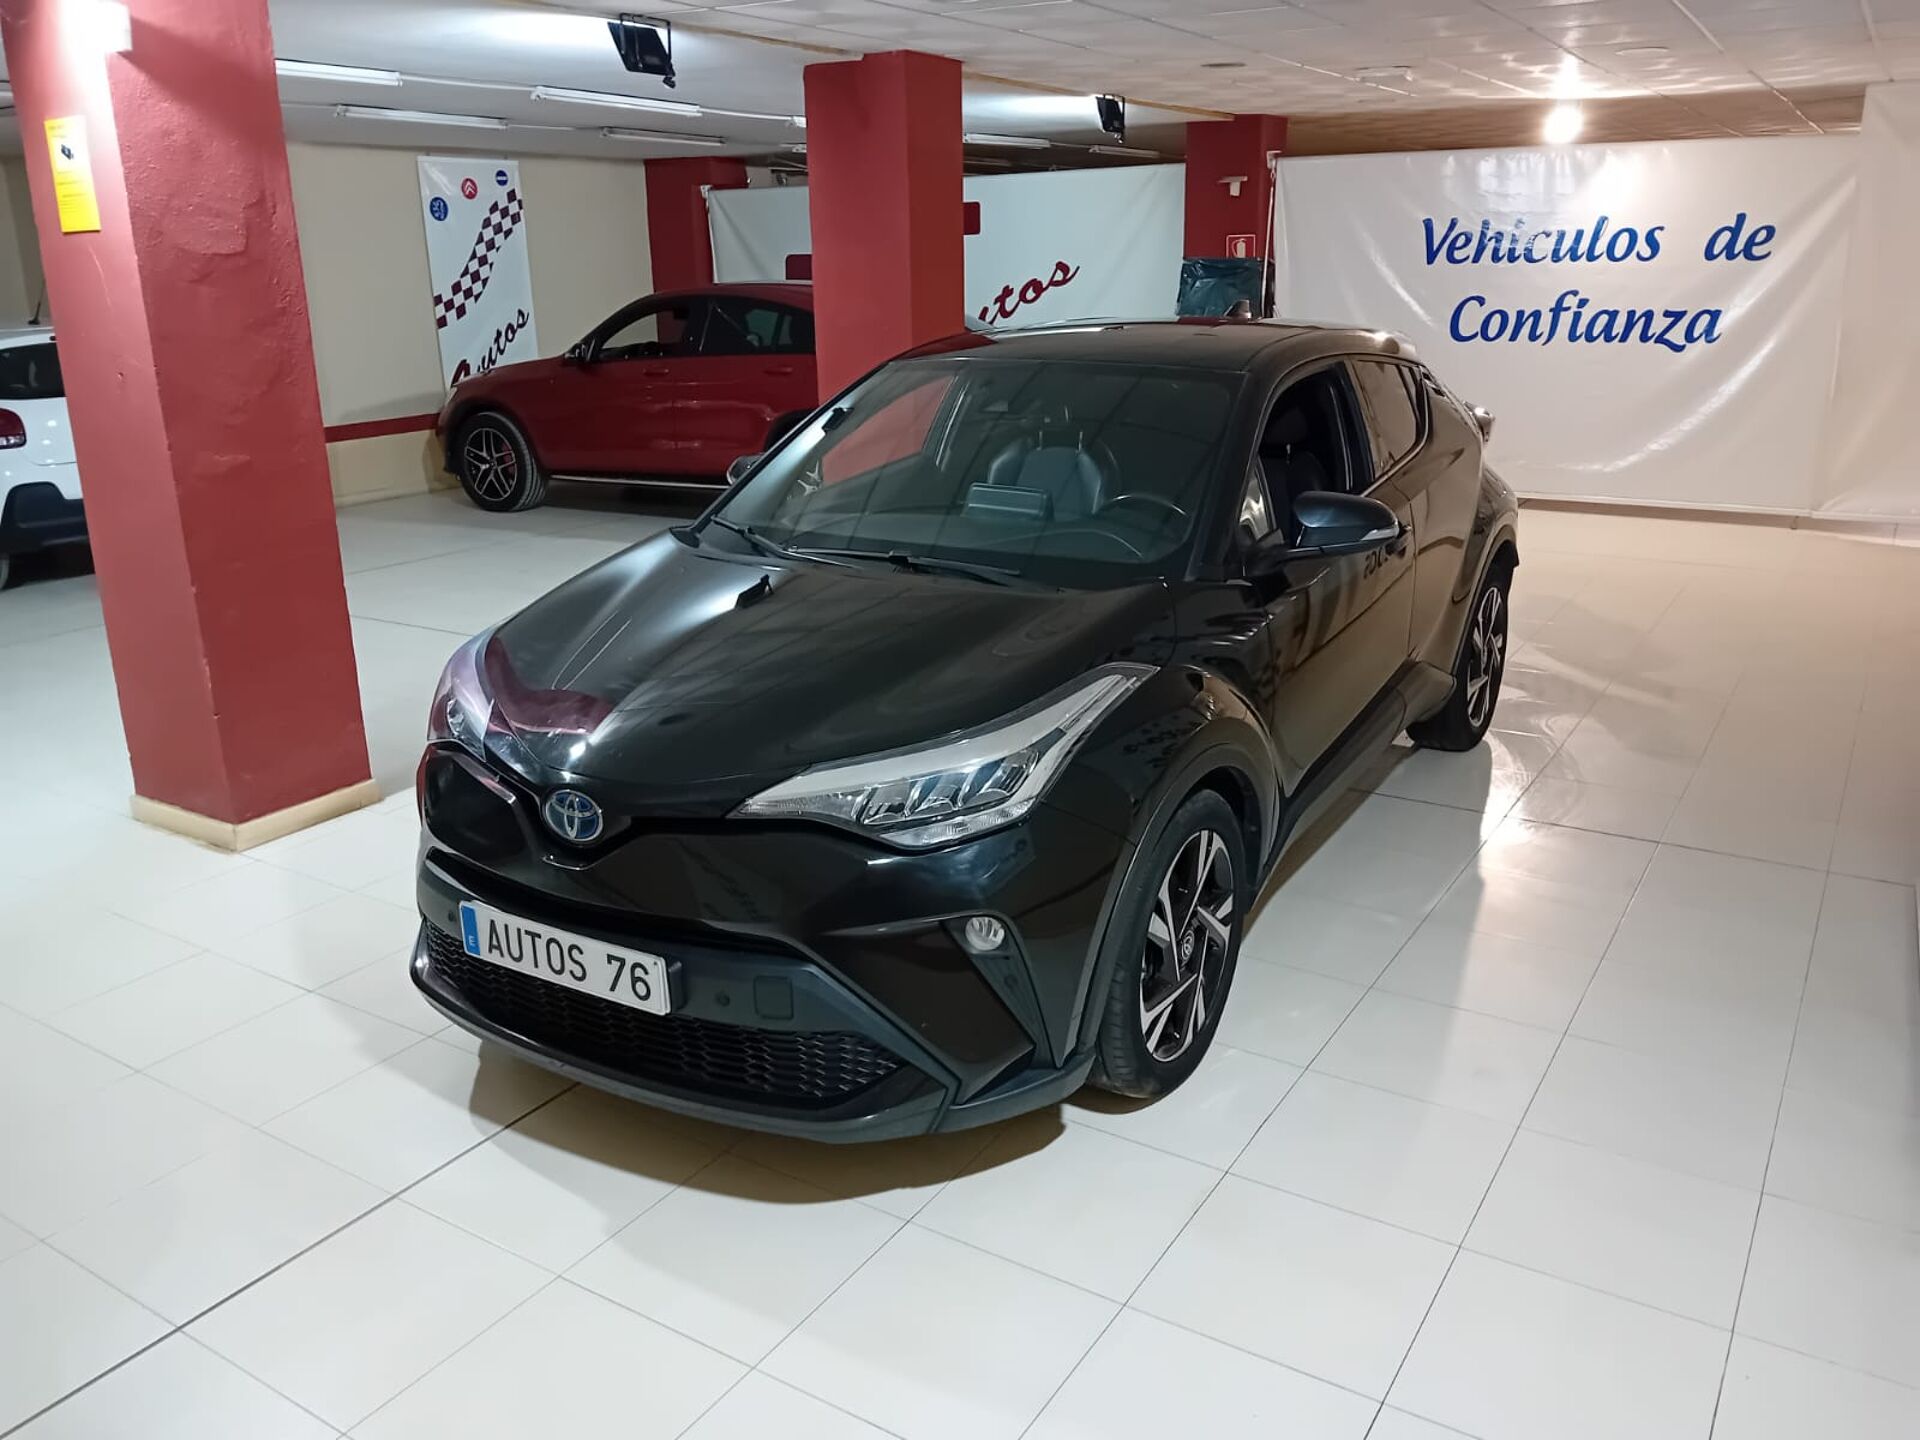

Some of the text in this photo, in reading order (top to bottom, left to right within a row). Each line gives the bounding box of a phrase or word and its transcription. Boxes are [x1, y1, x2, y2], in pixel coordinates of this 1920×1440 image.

[1704, 212, 1776, 261] de
[1449, 289, 1722, 353] Confianza
[487, 918, 652, 1002] AUTOS 76
